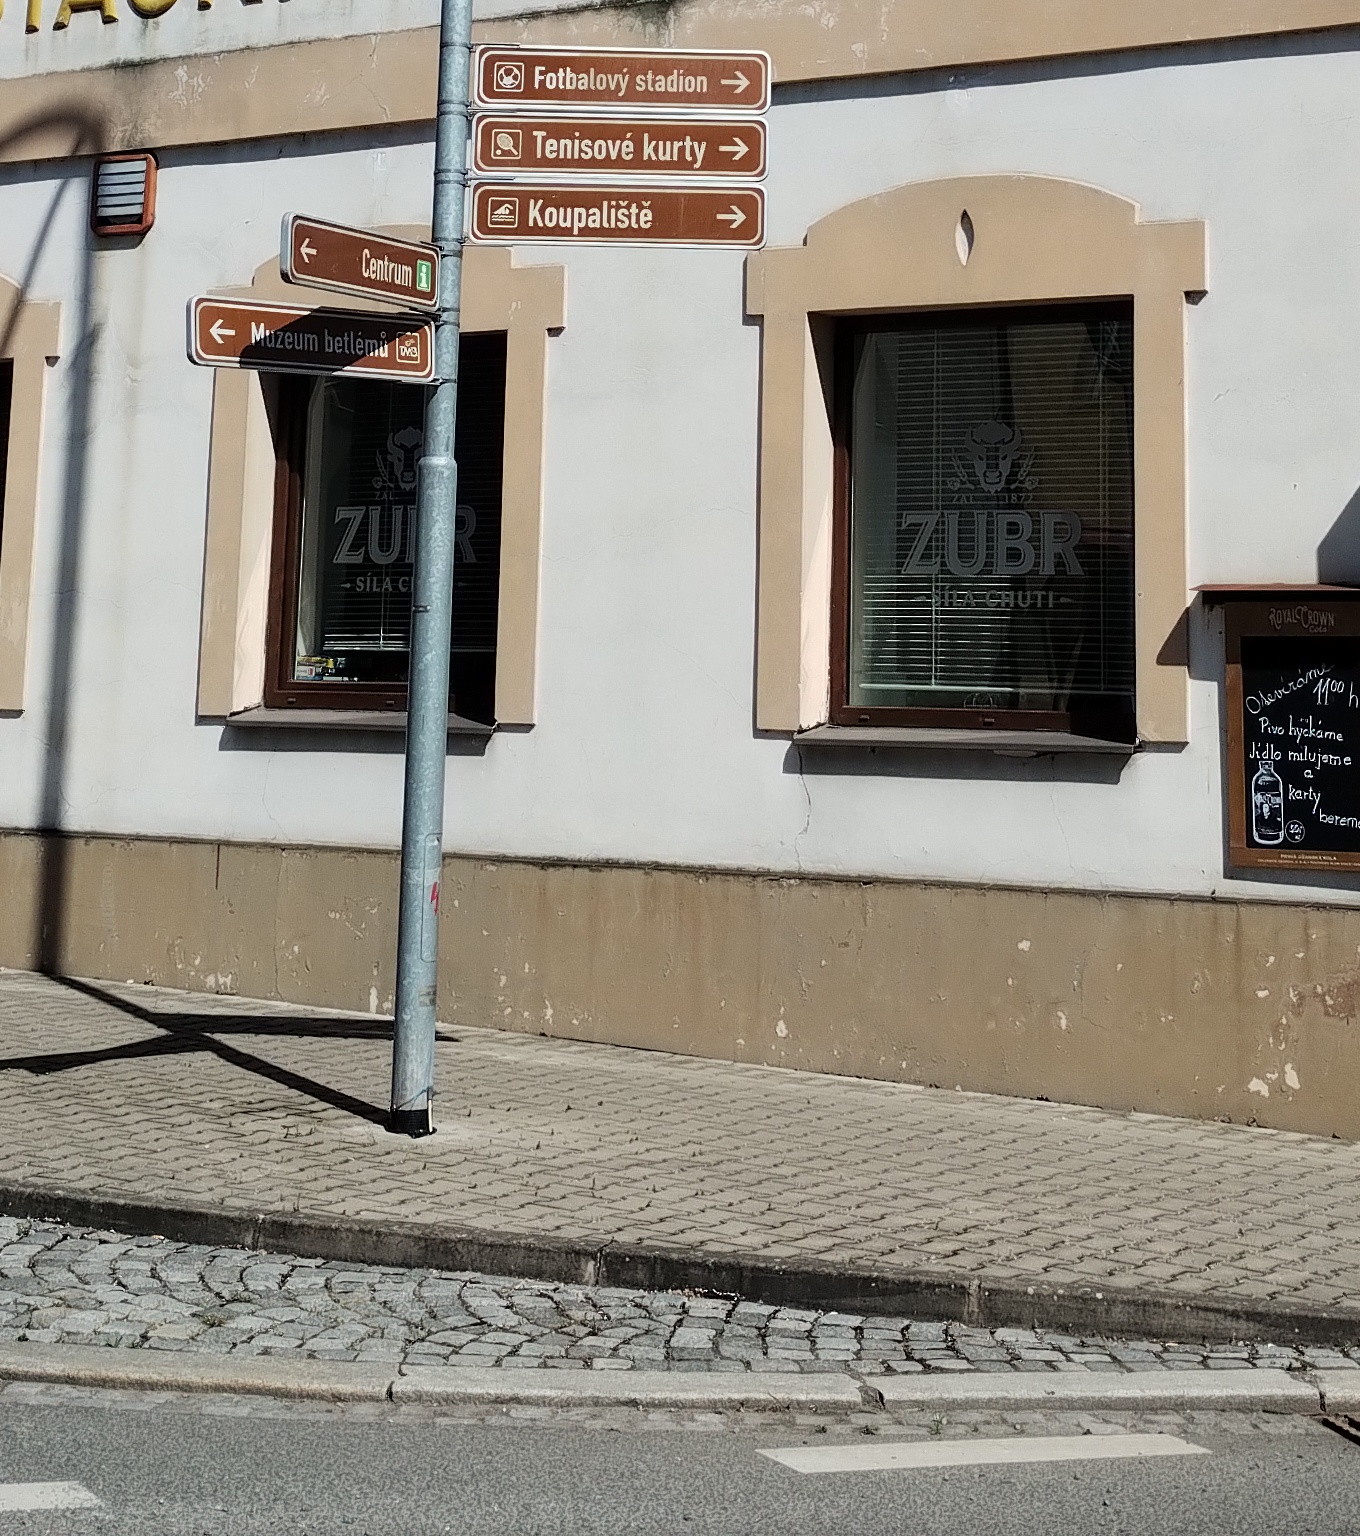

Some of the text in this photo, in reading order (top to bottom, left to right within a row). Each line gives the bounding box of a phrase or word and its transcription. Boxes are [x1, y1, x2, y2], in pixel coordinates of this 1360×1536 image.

[534, 66, 708, 96] Fotbalový stadion
[532, 131, 706, 168] Tenisové kurty
[528, 199, 654, 235] Koupaliště
[362, 248, 413, 289] Centrum
[251, 322, 319, 352] Muzeum
[324, 328, 389, 358] betlémů
[901, 509, 1085, 576] ZUBR
[356, 572, 393, 592] SÍLA
[1259, 717, 1285, 735] Pivo
[1289, 745, 1351, 770] milujeme
[1288, 784, 1321, 814] karty
